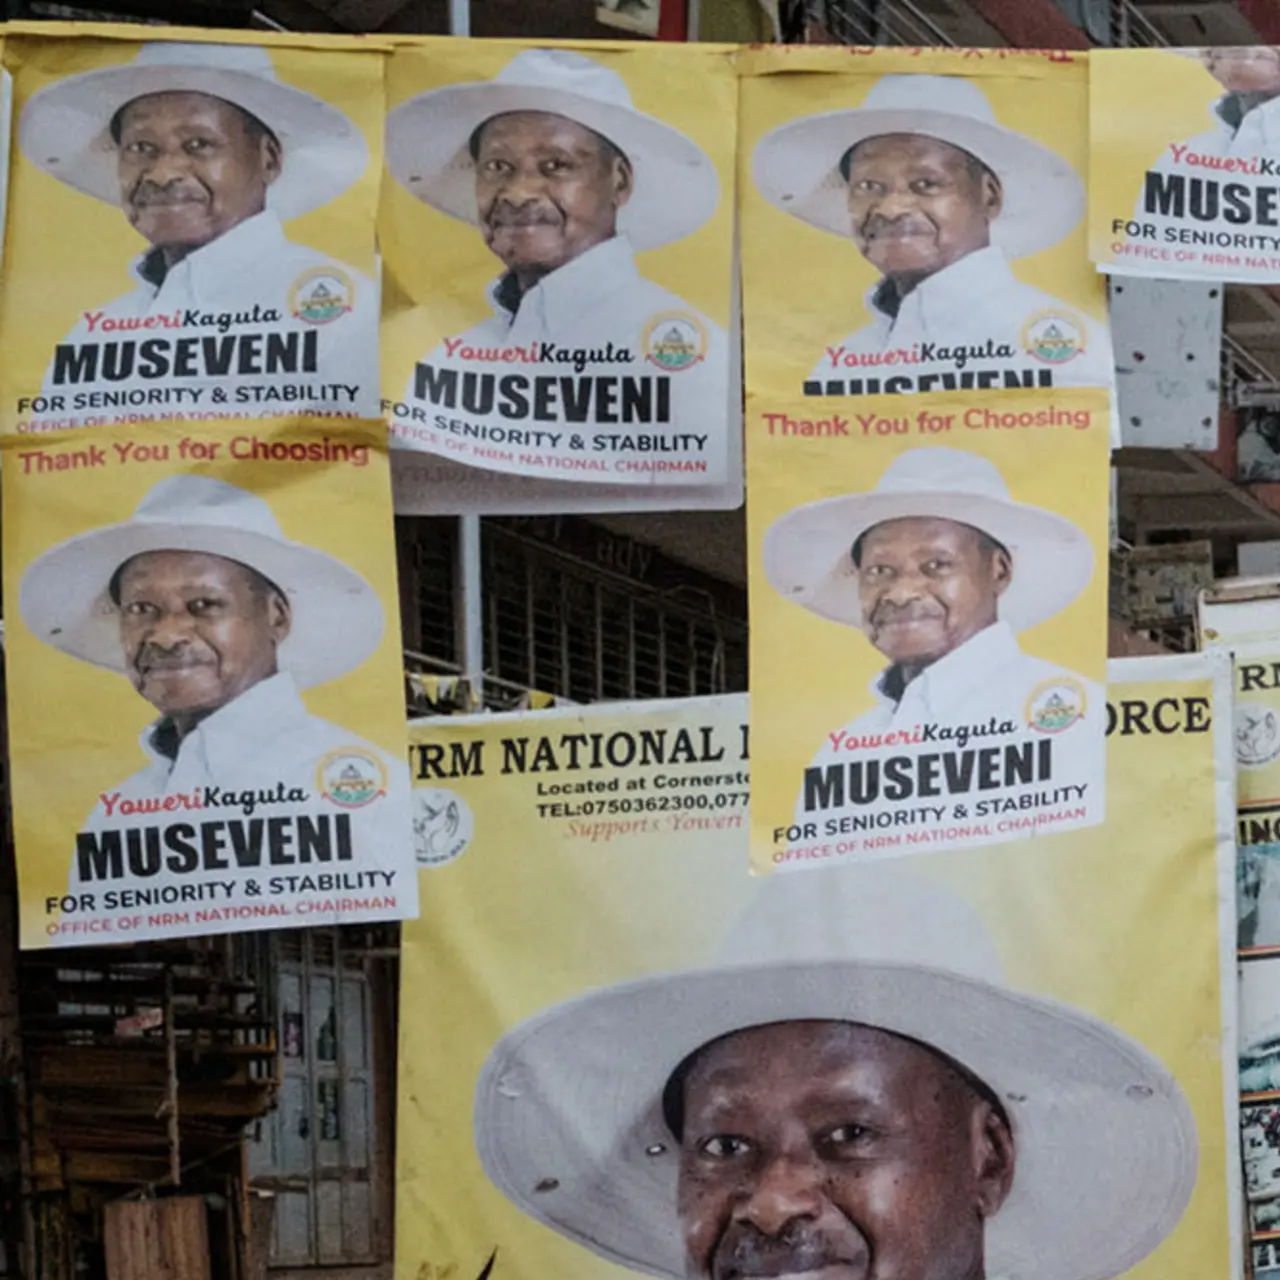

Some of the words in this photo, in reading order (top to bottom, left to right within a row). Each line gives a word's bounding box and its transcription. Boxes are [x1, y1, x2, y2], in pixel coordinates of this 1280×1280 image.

[1112, 219, 1157, 241] FOR
[52, 330, 317, 385] MUSEVENI
[17, 397, 65, 414] FOR
[73, 388, 204, 409] SENIORITY
[211, 387, 229, 403] &
[236, 384, 360, 403] STABILITY
[415, 361, 670, 423] MUSEVENI
[435, 415, 563, 449] SENIORITY
[569, 435, 585, 450] &
[593, 434, 708, 452] STABILITY
[761, 413, 849, 436] Thank
[855, 412, 908, 435] You
[916, 408, 955, 432] for
[963, 406, 1091, 429] Choosing
[18, 447, 106, 475] Thank
[113, 441, 168, 465] You
[178, 438, 222, 460] for
[229, 436, 372, 466] Choosing
[519, 453, 609, 471] NATIONAL
[615, 459, 707, 473] CHAIRMAN
[1105, 697, 1211, 738] RCE
[410, 741, 484, 780] RM
[501, 726, 725, 774] NATIONAL
[537, 781, 619, 797] Located
[626, 778, 646, 791] at
[804, 738, 1052, 812] MUSEVENI
[773, 824, 817, 843] FOR
[824, 807, 946, 838] SENIORITY
[953, 804, 968, 820] &
[975, 784, 1088, 817] STABILITY
[76, 813, 352, 883] MUSEVENI
[772, 844, 831, 863] OFFICE
[906, 823, 991, 845] NATIONAL
[997, 807, 1087, 833] CHAIRMAN
[45, 894, 96, 915] FOR
[103, 880, 237, 910] SENIORITY
[245, 879, 262, 896] &
[270, 871, 396, 894] STABILITY
[46, 917, 113, 937] OFFICE
[195, 903, 290, 923] NATIONAL
[296, 896, 396, 915] CHAIRMAN
